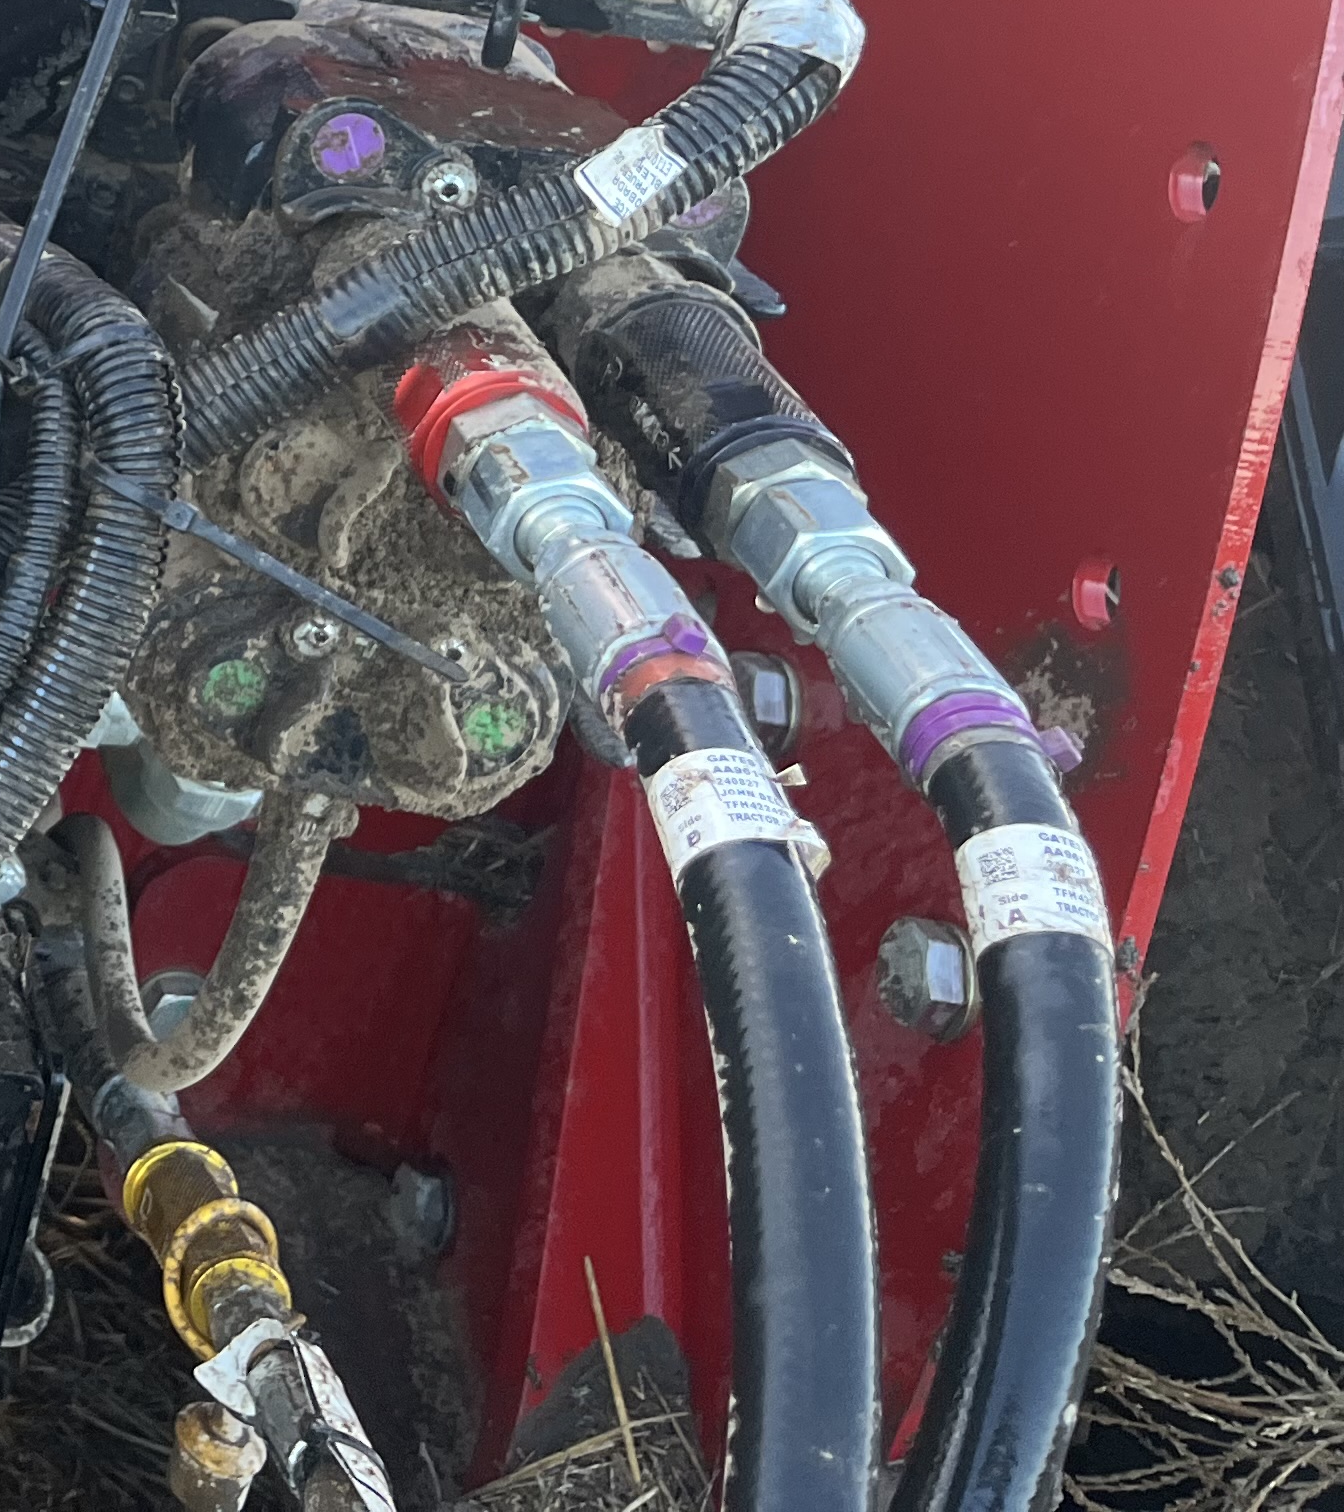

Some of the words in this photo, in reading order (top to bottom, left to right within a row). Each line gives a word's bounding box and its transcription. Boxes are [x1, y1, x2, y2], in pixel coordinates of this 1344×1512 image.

[707, 754, 755, 766] GATES
[721, 789, 754, 797] JOHN
[997, 893, 1028, 904] Side
